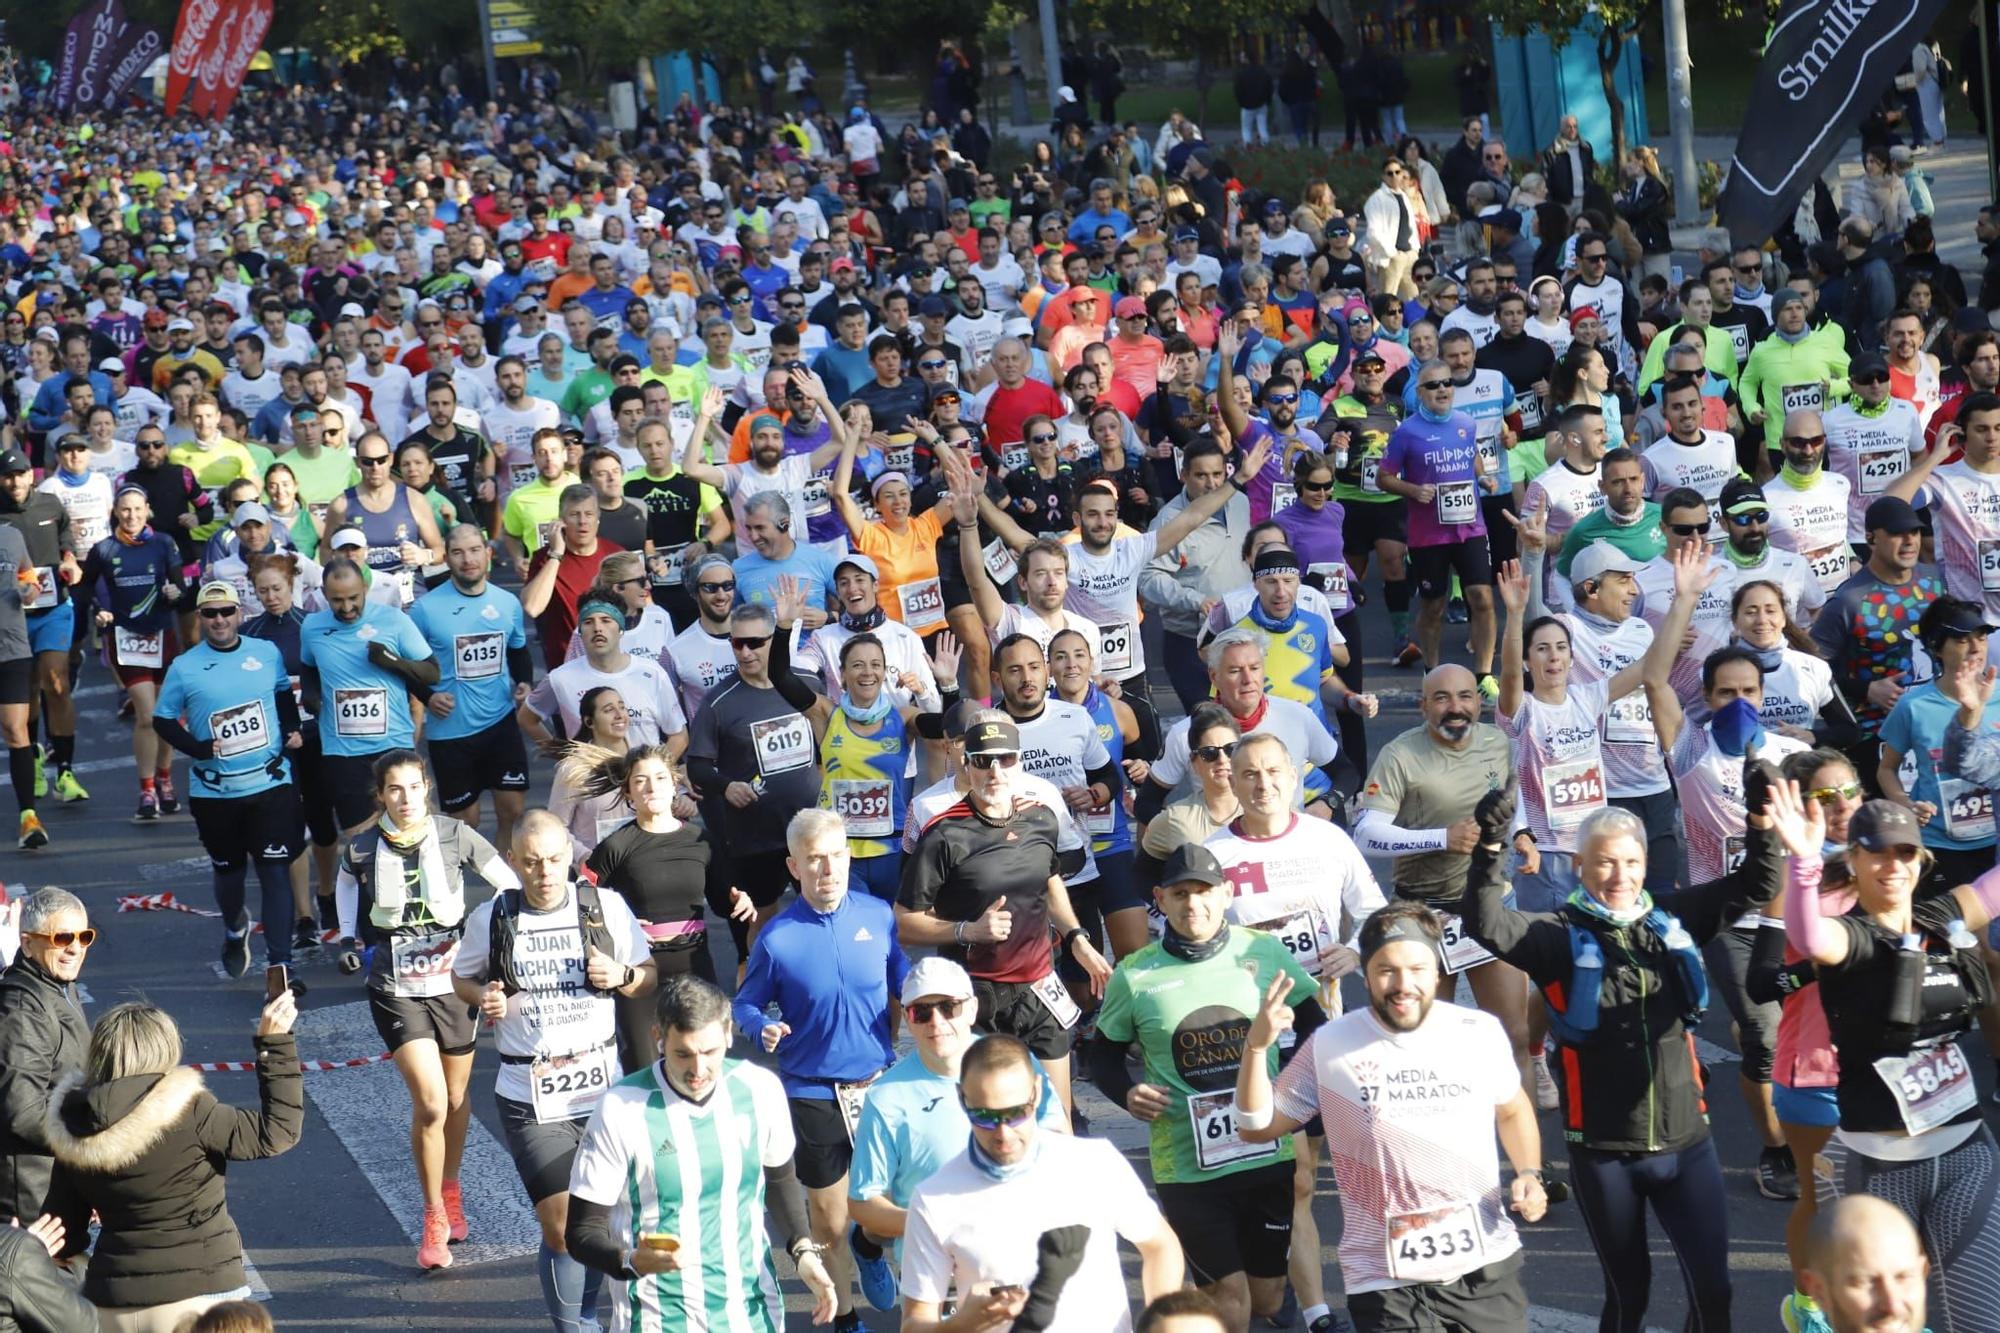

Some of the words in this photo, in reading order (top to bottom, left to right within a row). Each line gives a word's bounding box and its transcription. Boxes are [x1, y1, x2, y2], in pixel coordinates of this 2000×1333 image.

[109, 30, 160, 92] IMDECO
[1788, 393, 1820, 408] 6150
[1861, 431, 1887, 441] MEDIA
[1848, 440, 1858, 450] 37
[1424, 446, 1475, 466] FILÍPIDES
[1691, 464, 1714, 475] MEDIA
[1865, 461, 1903, 477] 4291
[513, 471, 537, 483] 529
[1680, 476, 1691, 487] 37
[1444, 494, 1474, 508] 5510
[1574, 501, 1584, 511] 37
[1982, 495, 2000, 504] MED
[648, 503, 691, 513] RAIL
[1807, 504, 1835, 516] MEDIA
[1968, 506, 1979, 514] 37
[1793, 517, 1805, 528] 37
[1079, 579, 1090, 589] 37
[1324, 576, 1347, 591] 972
[909, 592, 938, 612] 5136
[121, 639, 158, 652] 4926
[1101, 639, 1126, 654] 09
[463, 646, 497, 662] 6135
[703, 676, 715, 687] 37
[1763, 696, 1792, 707] EDIA
[342, 703, 380, 718] 6136
[221, 716, 260, 739] 6138
[767, 730, 802, 752] 6119
[1555, 779, 1601, 804] 5914
[837, 796, 888, 816] 5039
[1367, 839, 1389, 851] TRAIL
[525, 934, 572, 952] JUAN
[1283, 932, 1313, 955] 58
[515, 959, 559, 979] UCHA
[520, 1006, 541, 1017] LUNA
[544, 1005, 555, 1015] ES
[558, 1003, 569, 1014] TU
[1182, 1029, 1223, 1050] ORO
[1228, 1027, 1248, 1043] DE
[1182, 1046, 1243, 1068] CÁNAV
[541, 1067, 604, 1095] 5228
[1387, 1068, 1438, 1085] MEDIA
[1900, 1048, 1963, 1101] 5845
[1360, 1086, 1379, 1102] 37
[1206, 1113, 1239, 1139] 61
[1400, 1228, 1475, 1261] 4333
